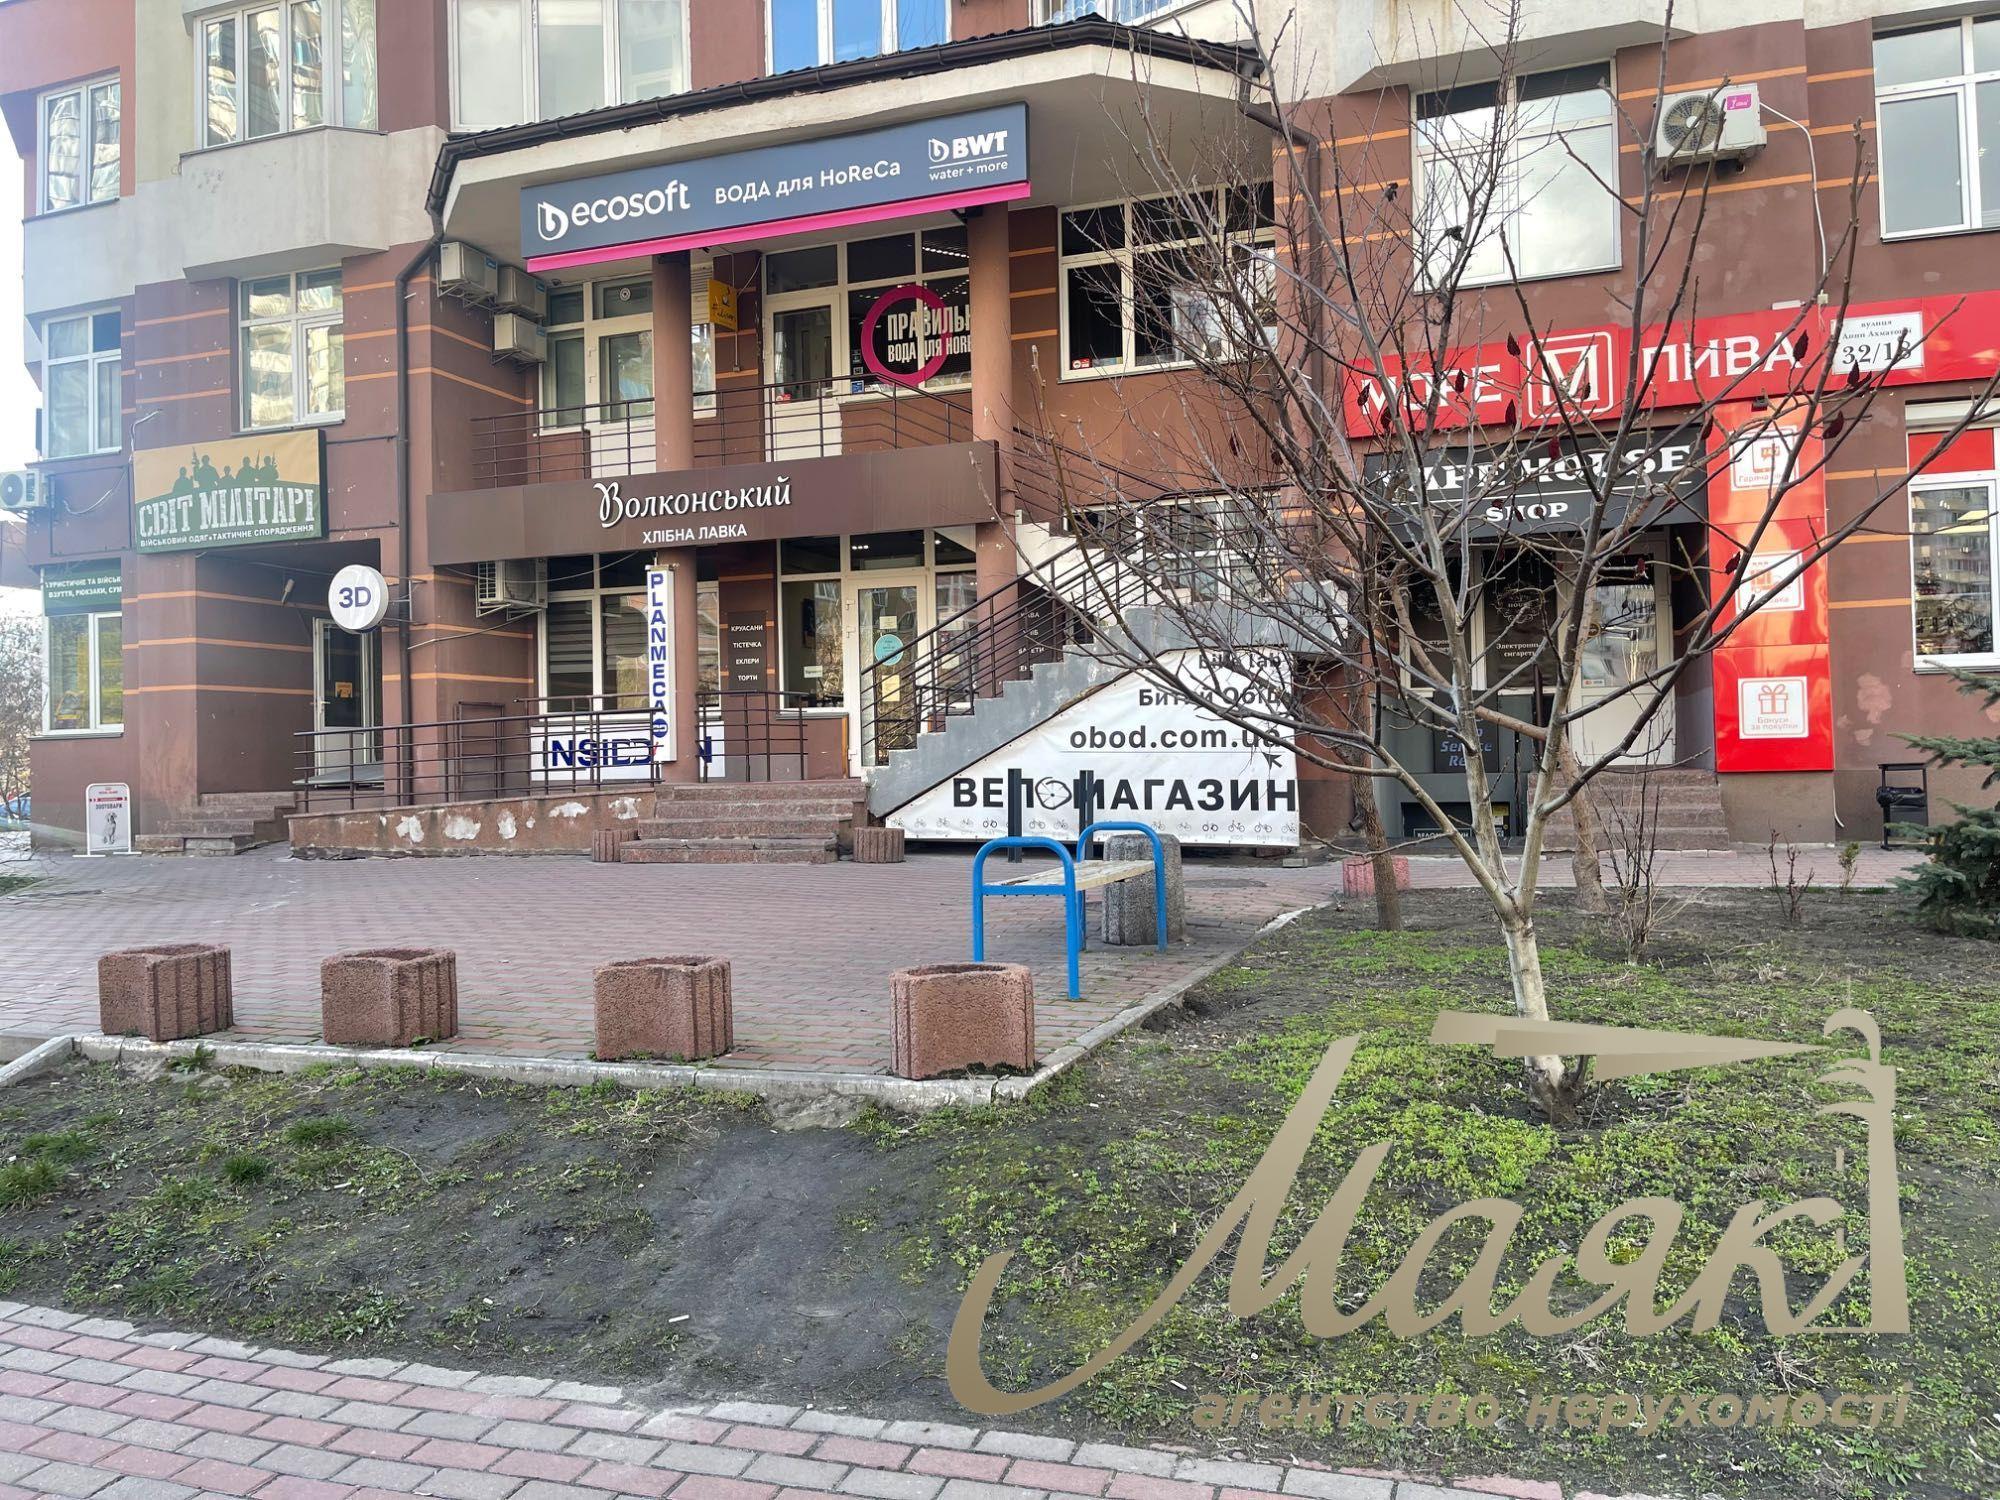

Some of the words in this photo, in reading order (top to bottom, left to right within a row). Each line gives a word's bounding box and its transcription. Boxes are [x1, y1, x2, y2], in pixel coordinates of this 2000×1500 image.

[952, 130, 1008, 159] BWT
[929, 168, 965, 181] water
[976, 159, 1008, 174] more
[715, 180, 771, 204] ВОДА
[776, 175, 813, 198] для
[820, 160, 901, 187] HoReCa
[571, 179, 691, 226] ecosoft
[887, 342, 917, 363] ВОДА
[1642, 331, 1804, 385] ПИВА
[139, 494, 193, 538] СВІТ
[199, 486, 315, 530] МІЛІТАРІ
[592, 475, 792, 529] Волконський
[213, 530, 253, 541] ТАКТИЧНЕ
[254, 524, 315, 537] СПОРЯДЖЕННЯ
[643, 528, 695, 544] ХЛІБНА
[698, 523, 748, 540] ЛАВКА
[338, 586, 372, 609] 3D
[730, 624, 763, 632] КРУАСАНИ
[649, 573, 667, 715] PLANMECA
[732, 641, 762, 649] ТІСТЕЧКА
[735, 657, 760, 665] ЕКЛЕРИ
[737, 674, 758, 682] ТОРТИ
[1069, 725, 1281, 749] obod.com.ua
